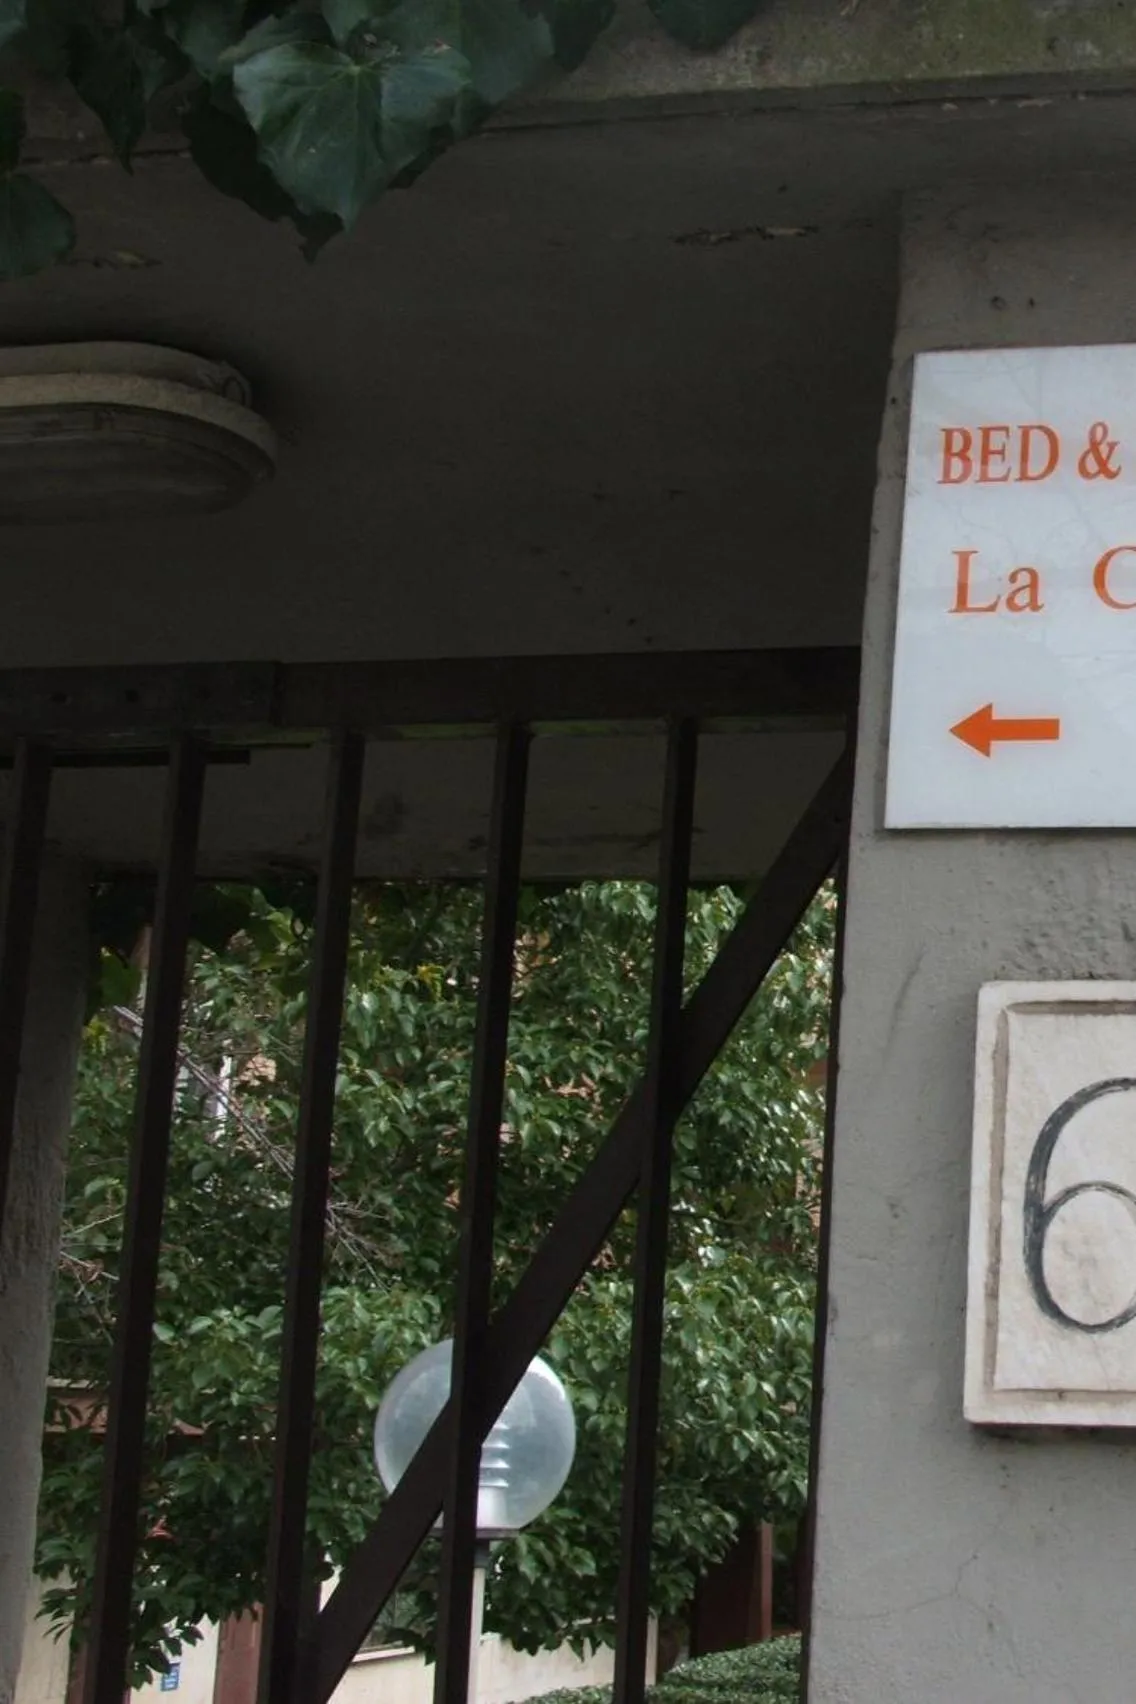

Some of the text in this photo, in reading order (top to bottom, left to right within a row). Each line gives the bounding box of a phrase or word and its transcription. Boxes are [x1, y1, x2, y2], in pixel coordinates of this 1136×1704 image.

[938, 423, 1061, 485] BED
[1077, 420, 1122, 480] &
[948, 549, 1045, 615] La
